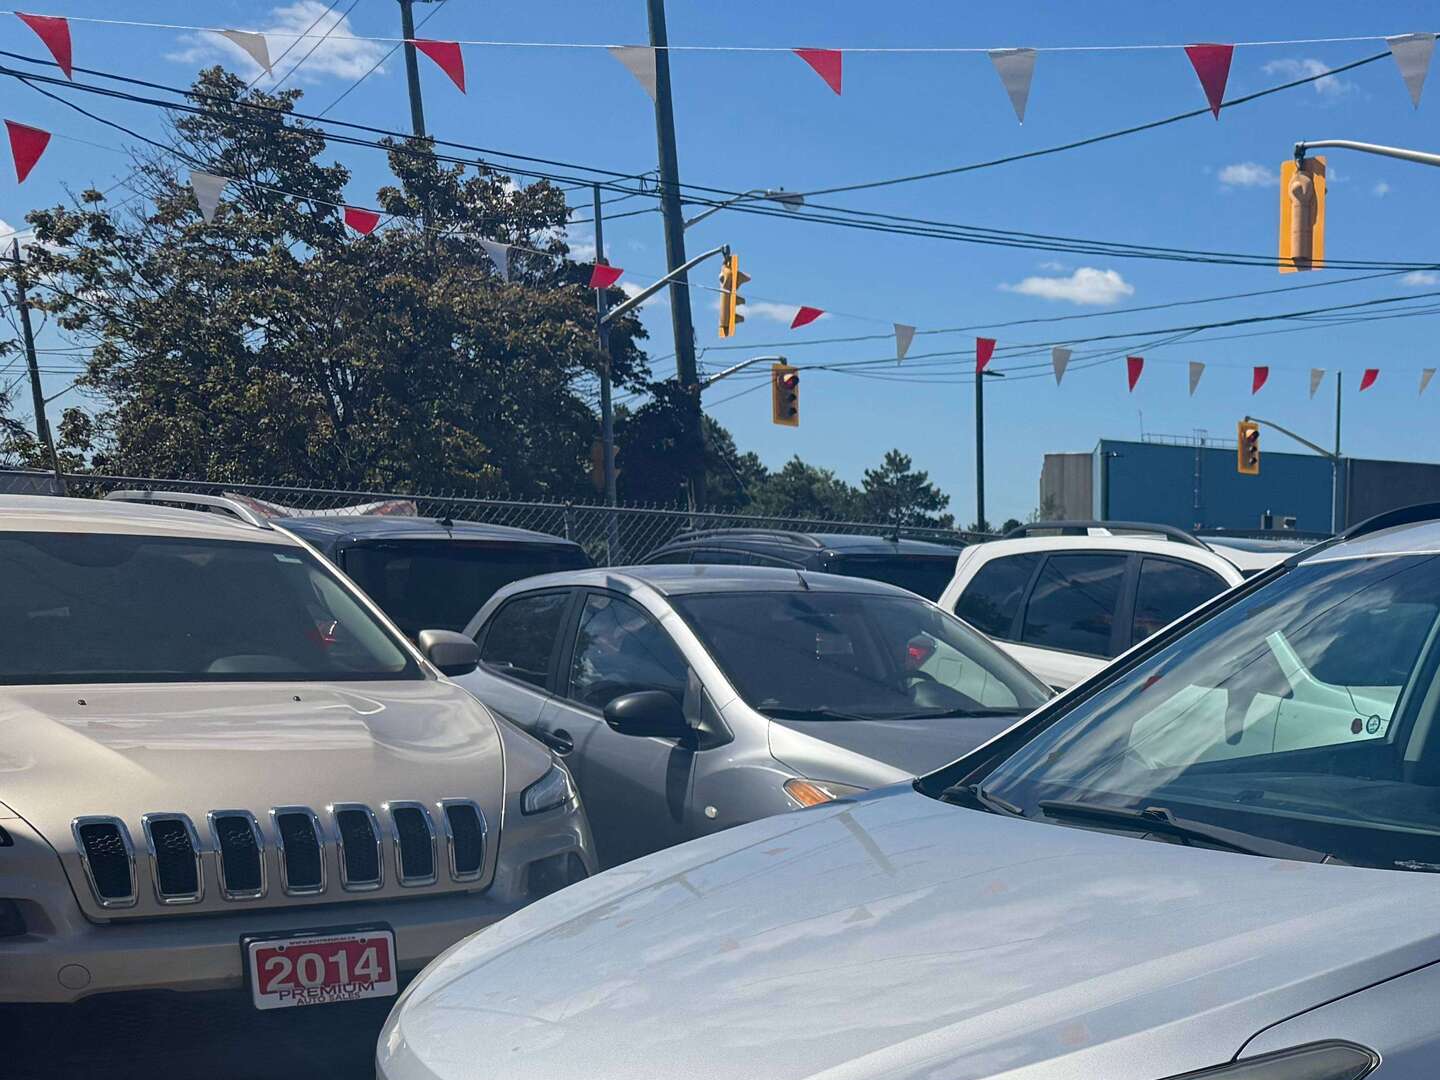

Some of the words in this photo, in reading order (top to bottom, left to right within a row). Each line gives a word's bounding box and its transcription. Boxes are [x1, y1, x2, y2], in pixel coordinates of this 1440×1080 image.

[264, 947, 383, 992] 2014
[279, 982, 376, 1001] PREMIUM
[296, 996, 324, 1006] AUTO
[329, 991, 361, 1002] SALES
